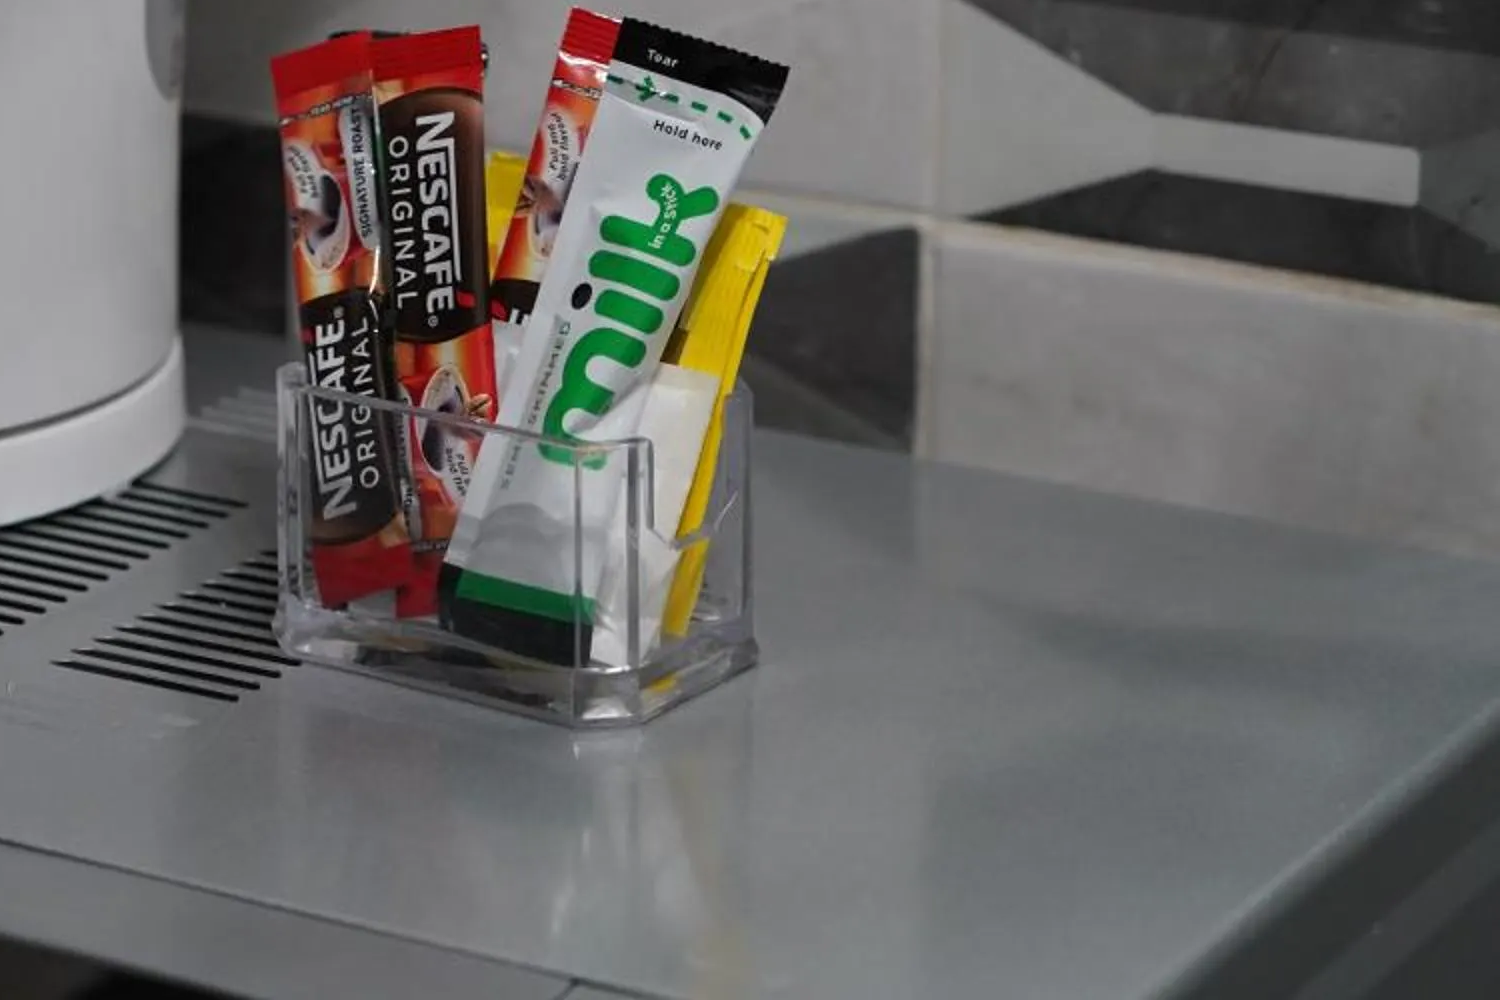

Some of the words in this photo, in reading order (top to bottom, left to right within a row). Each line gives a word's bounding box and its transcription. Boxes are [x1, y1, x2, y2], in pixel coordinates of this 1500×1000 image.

[647, 48, 679, 68] Tear
[350, 108, 363, 151] ROAST
[653, 119, 687, 140] Hold
[692, 131, 723, 151] here
[352, 157, 374, 238] SIGNATURE
[389, 136, 419, 309] ORIGINAL
[660, 222, 669, 234] a
[537, 173, 719, 470] milk
[351, 316, 381, 489] ORIGINAL
